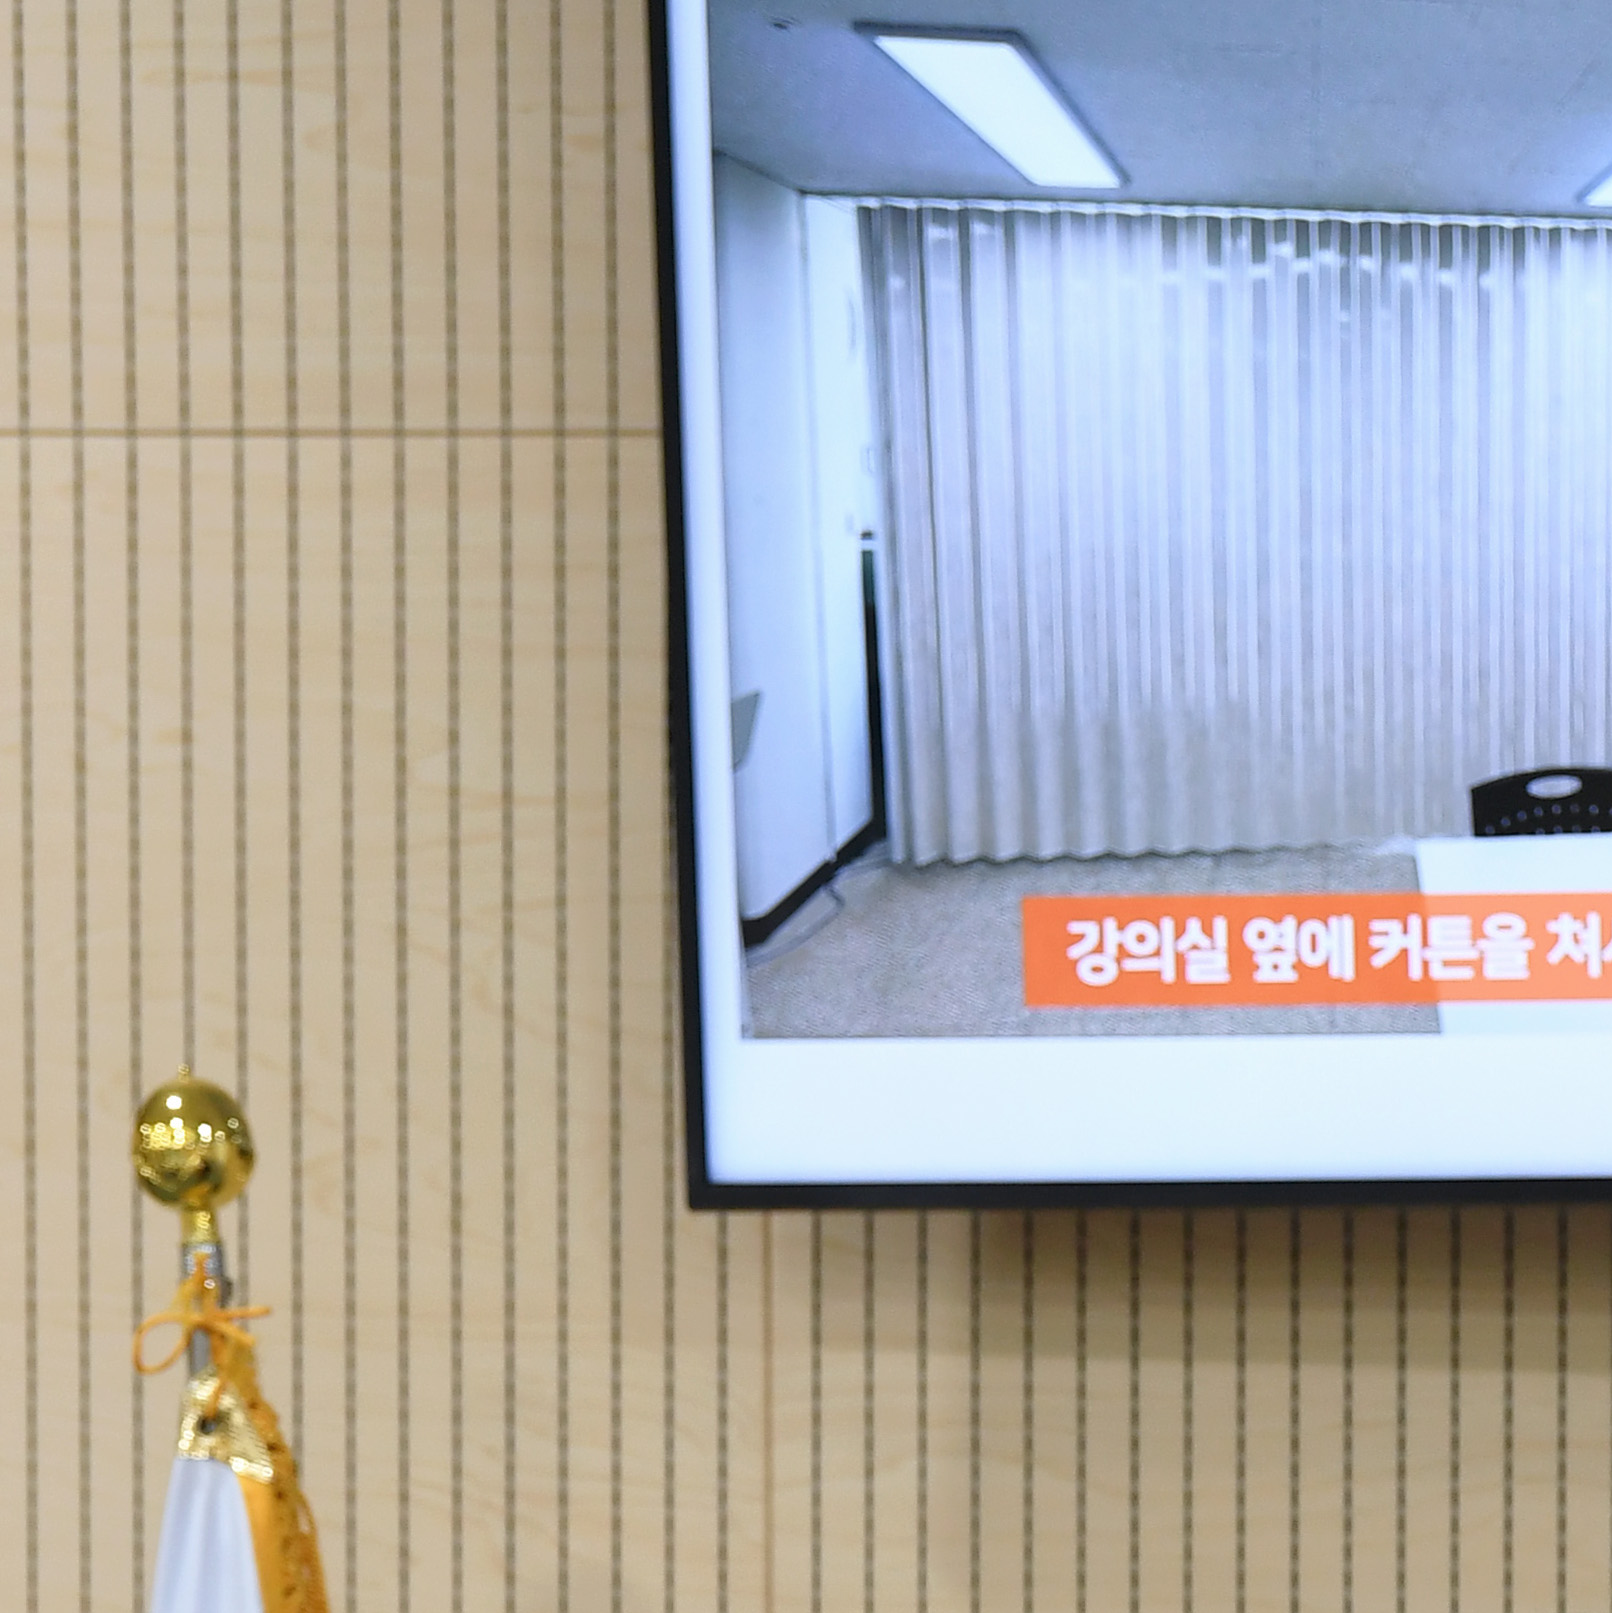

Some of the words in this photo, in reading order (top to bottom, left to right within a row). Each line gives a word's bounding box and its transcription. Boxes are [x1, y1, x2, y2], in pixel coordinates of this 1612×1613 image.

[1066, 914, 1231, 986] 강의실
[1242, 913, 1355, 984] 옆에
[1368, 911, 1535, 982] 커튼을
